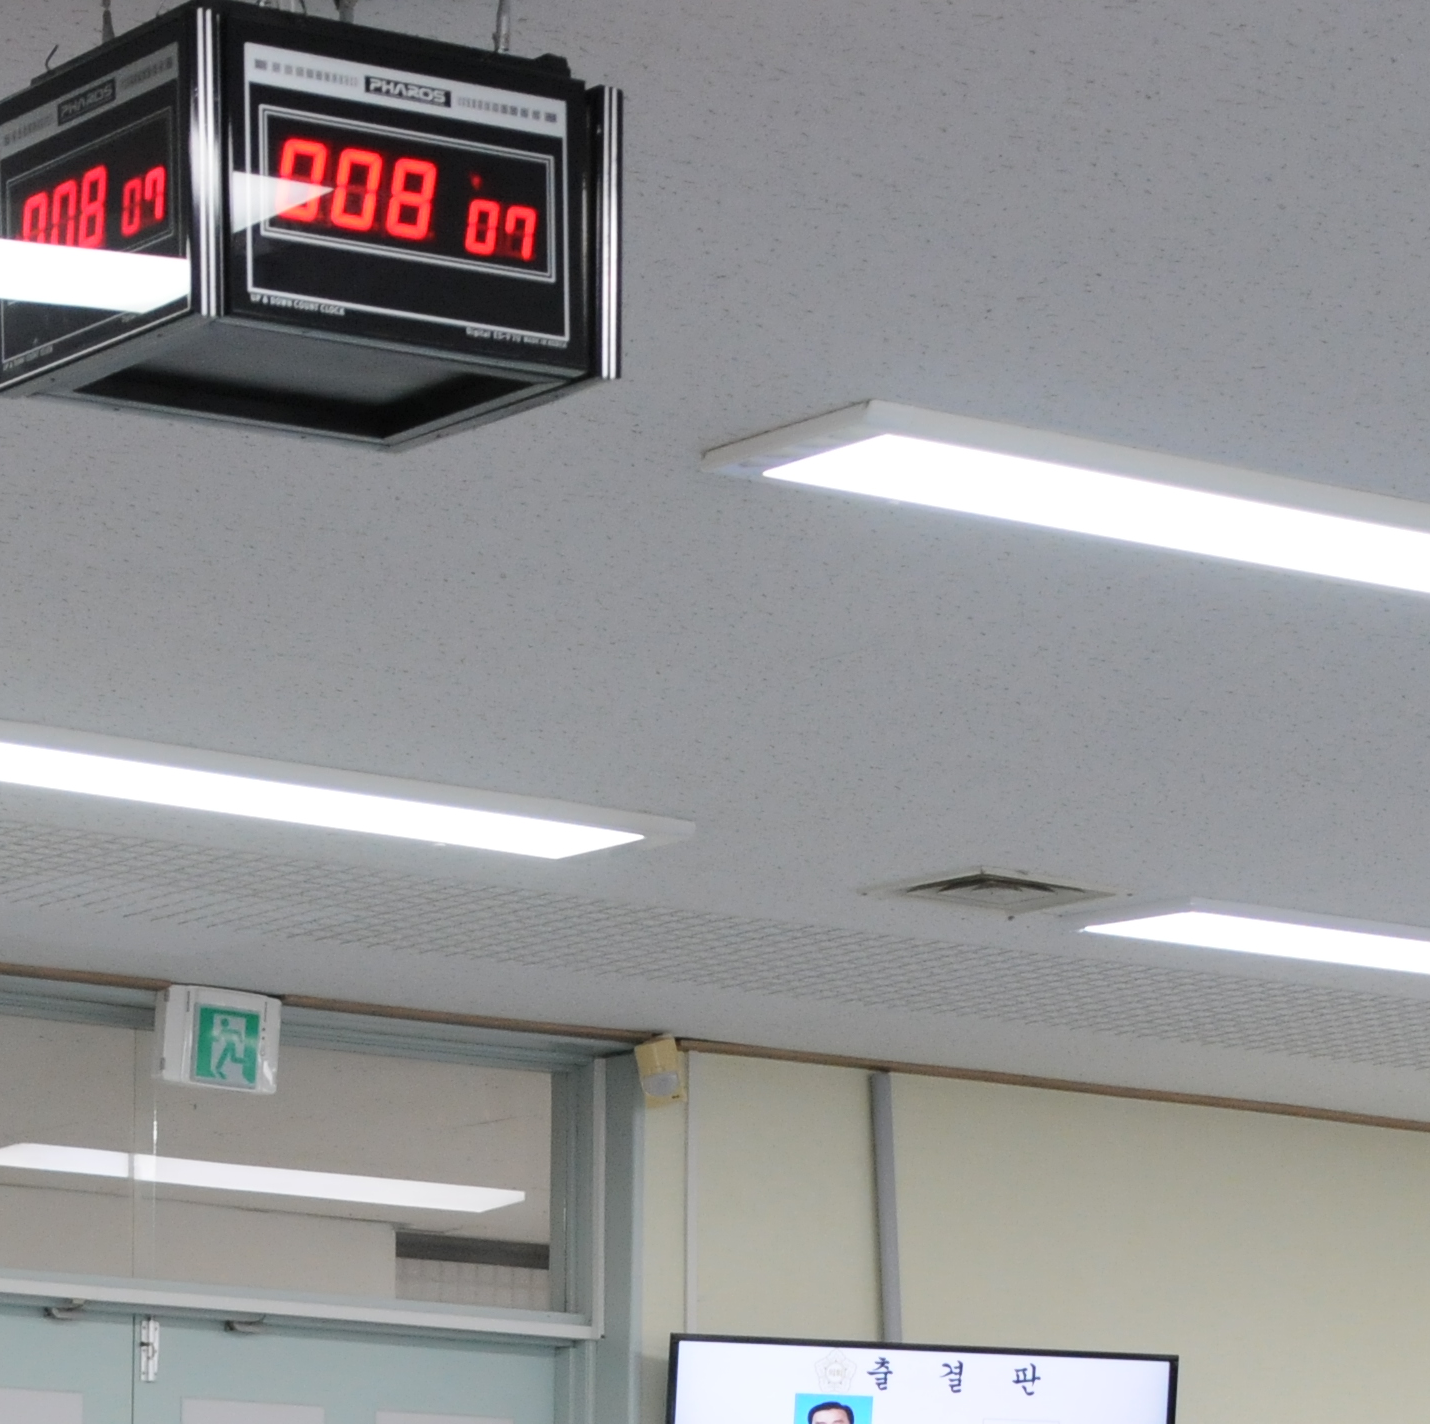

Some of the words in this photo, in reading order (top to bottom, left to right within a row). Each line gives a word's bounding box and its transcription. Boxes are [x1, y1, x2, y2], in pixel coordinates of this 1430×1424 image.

[368, 77, 446, 104] PHAROS
[121, 165, 166, 237] 07
[276, 139, 437, 240] 008
[465, 199, 537, 261] 07
